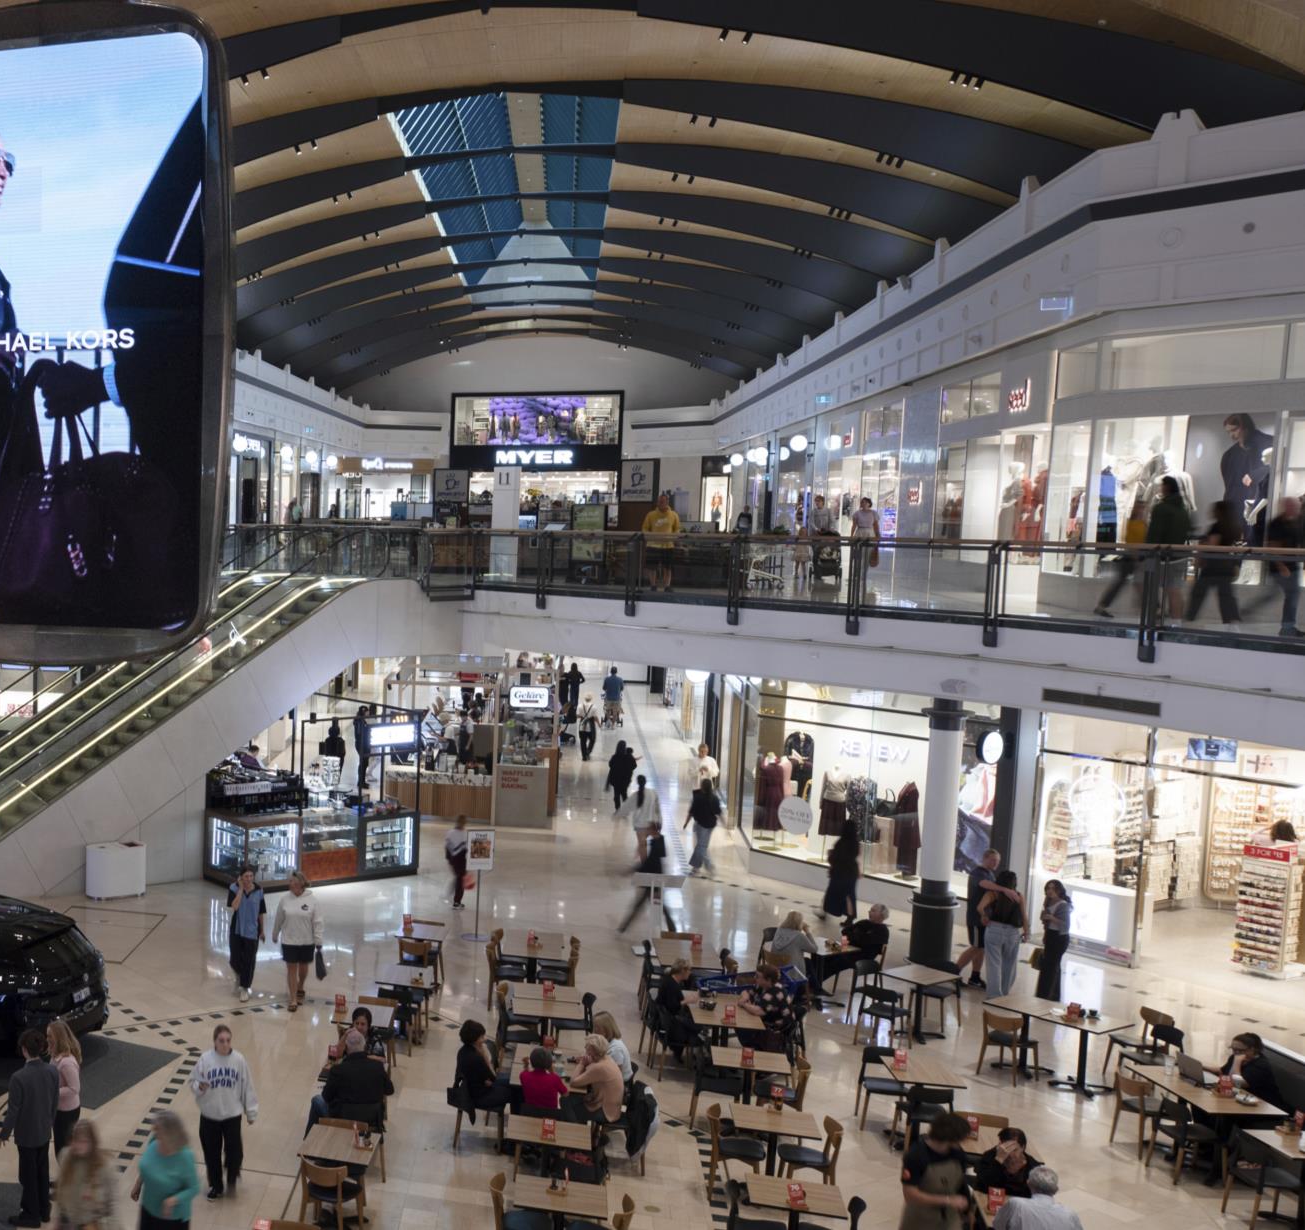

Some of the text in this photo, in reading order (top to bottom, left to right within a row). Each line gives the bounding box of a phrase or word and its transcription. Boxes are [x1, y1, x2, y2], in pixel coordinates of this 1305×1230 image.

[66, 328, 135, 350] KORS
[1008, 377, 1031, 412] seed
[495, 450, 574, 464] MYER
[839, 740, 911, 764] REVIEW
